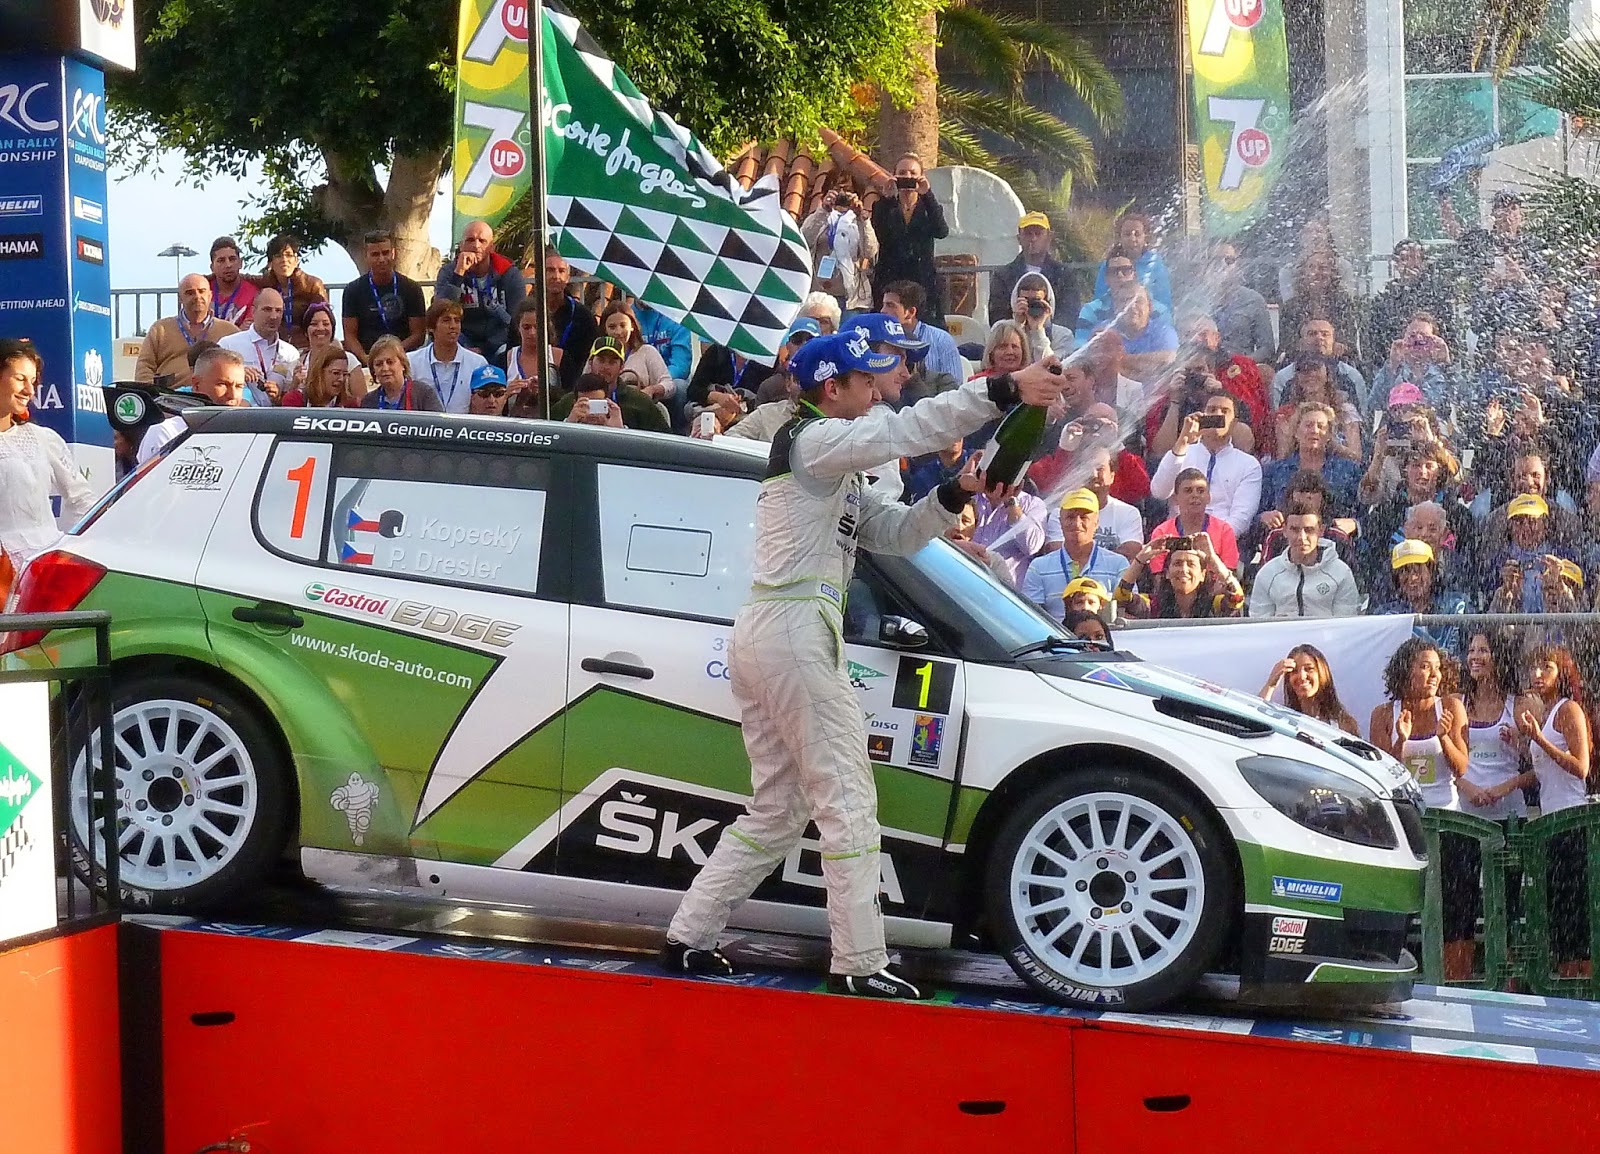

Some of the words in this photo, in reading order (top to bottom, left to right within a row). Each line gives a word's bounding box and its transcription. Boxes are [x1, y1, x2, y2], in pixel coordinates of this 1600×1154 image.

[17, 137, 58, 149] RALLY
[36, 298, 66, 308] AHEAD
[292, 416, 383, 434] ŠKODA
[387, 422, 454, 439] Genuine
[286, 457, 316, 539] 1
[420, 517, 524, 555] Kopecký
[388, 547, 407, 571] P.
[415, 551, 503, 581] Dresler
[323, 588, 392, 616] Castrol
[390, 599, 523, 649] EDGE
[712, 637, 729, 652] 3
[290, 632, 473, 691] www.skoda-auto.com
[915, 661, 933, 709] 1
[1287, 882, 1338, 897] MICHELIN
[1279, 919, 1304, 935] Castrol
[1268, 936, 1307, 954] EDGE
[1014, 950, 1100, 1003] MICHELIN
